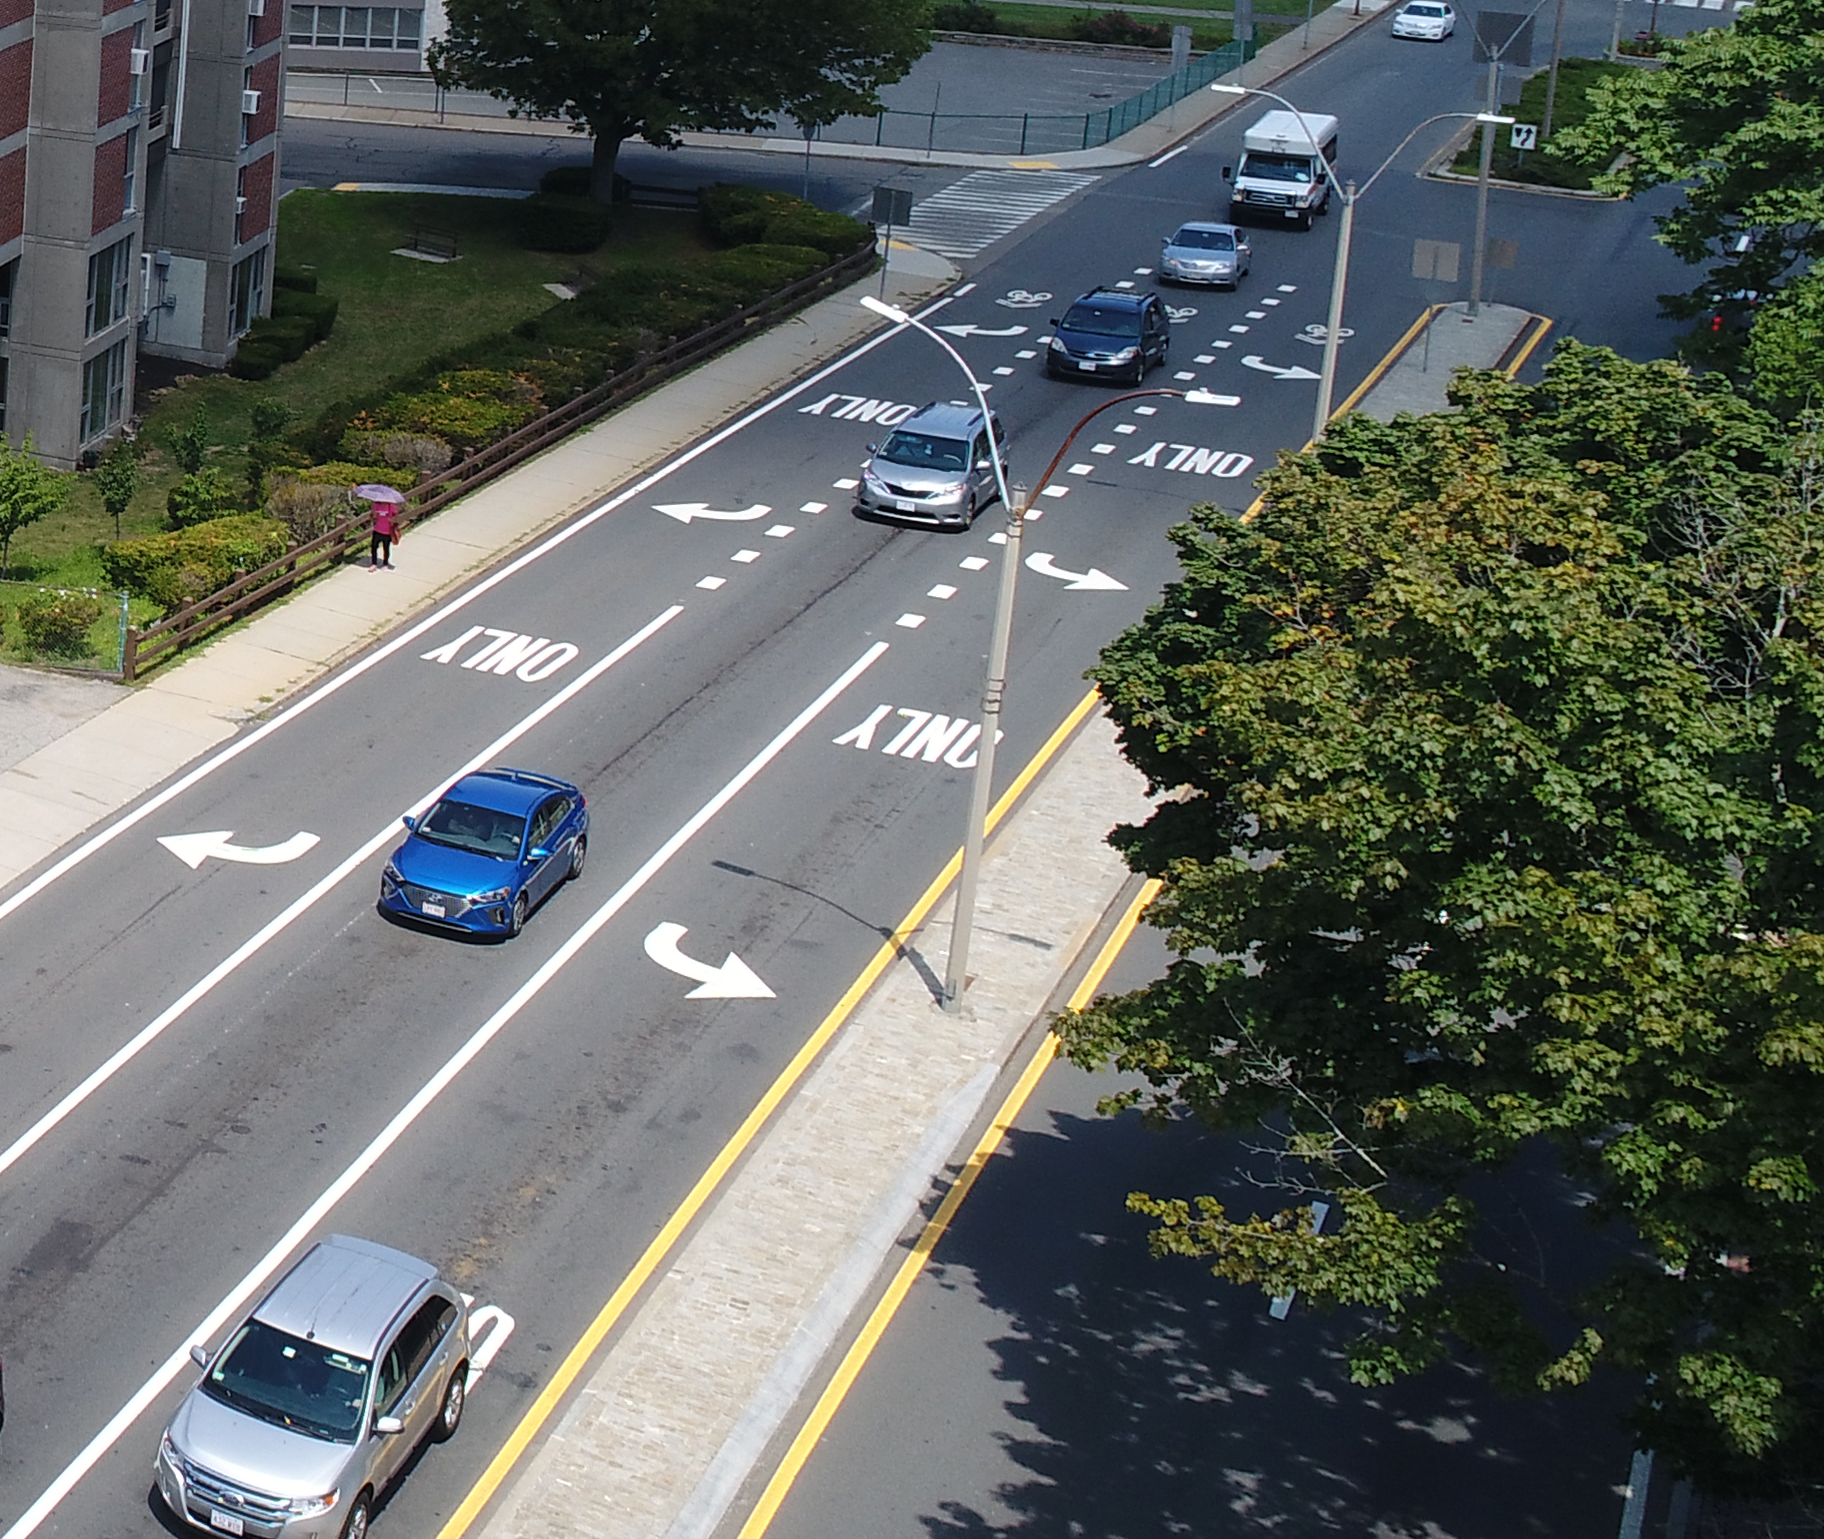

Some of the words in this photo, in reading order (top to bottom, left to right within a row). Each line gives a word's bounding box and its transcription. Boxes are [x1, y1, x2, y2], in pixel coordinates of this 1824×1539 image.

[797, 393, 918, 426] ONLY
[1127, 441, 1255, 478] ONLY
[420, 625, 579, 683] ONLY
[832, 703, 1003, 770] ONLY
